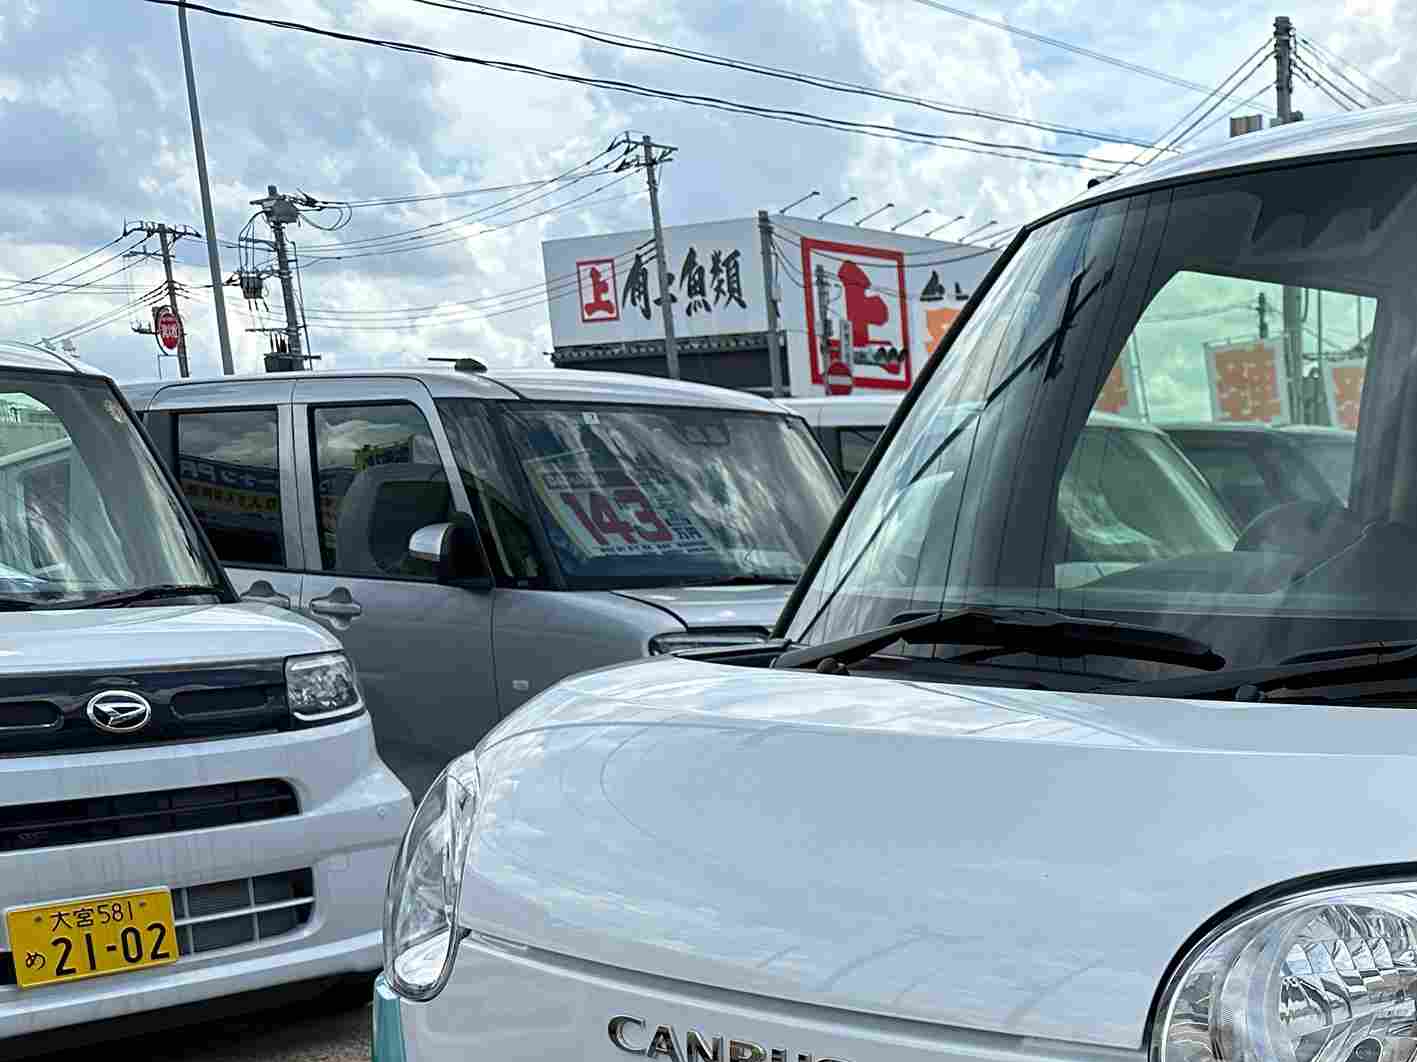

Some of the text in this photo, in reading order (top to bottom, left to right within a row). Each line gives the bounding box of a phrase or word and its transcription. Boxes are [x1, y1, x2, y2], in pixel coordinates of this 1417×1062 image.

[560, 490, 673, 545] 143
[50, 902, 135, 931] 大宮581
[24, 922, 171, 977] め 21-02
